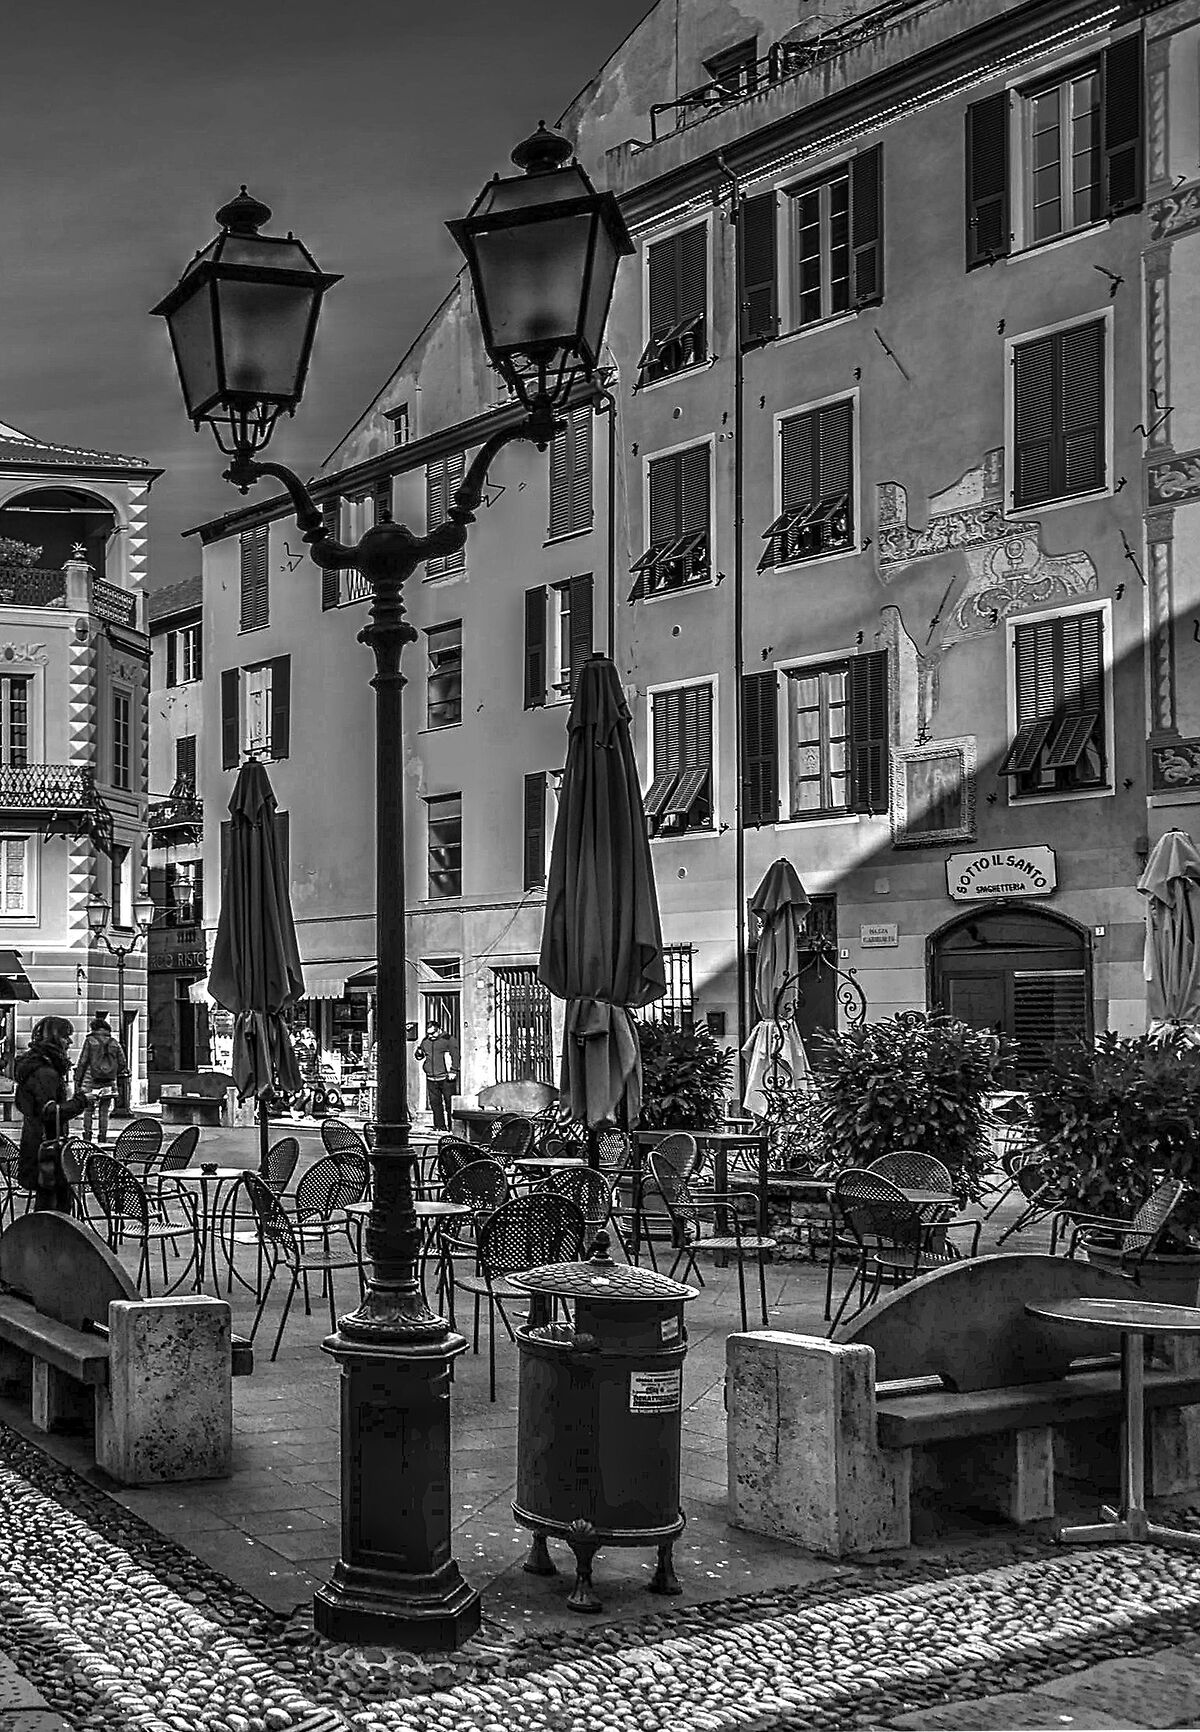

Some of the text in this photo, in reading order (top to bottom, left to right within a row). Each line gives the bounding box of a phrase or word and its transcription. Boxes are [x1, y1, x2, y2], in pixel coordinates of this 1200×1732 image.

[956, 854, 1047, 894] SOTTO IL SANTO
[975, 882, 1026, 894] SPAGHETTERIA
